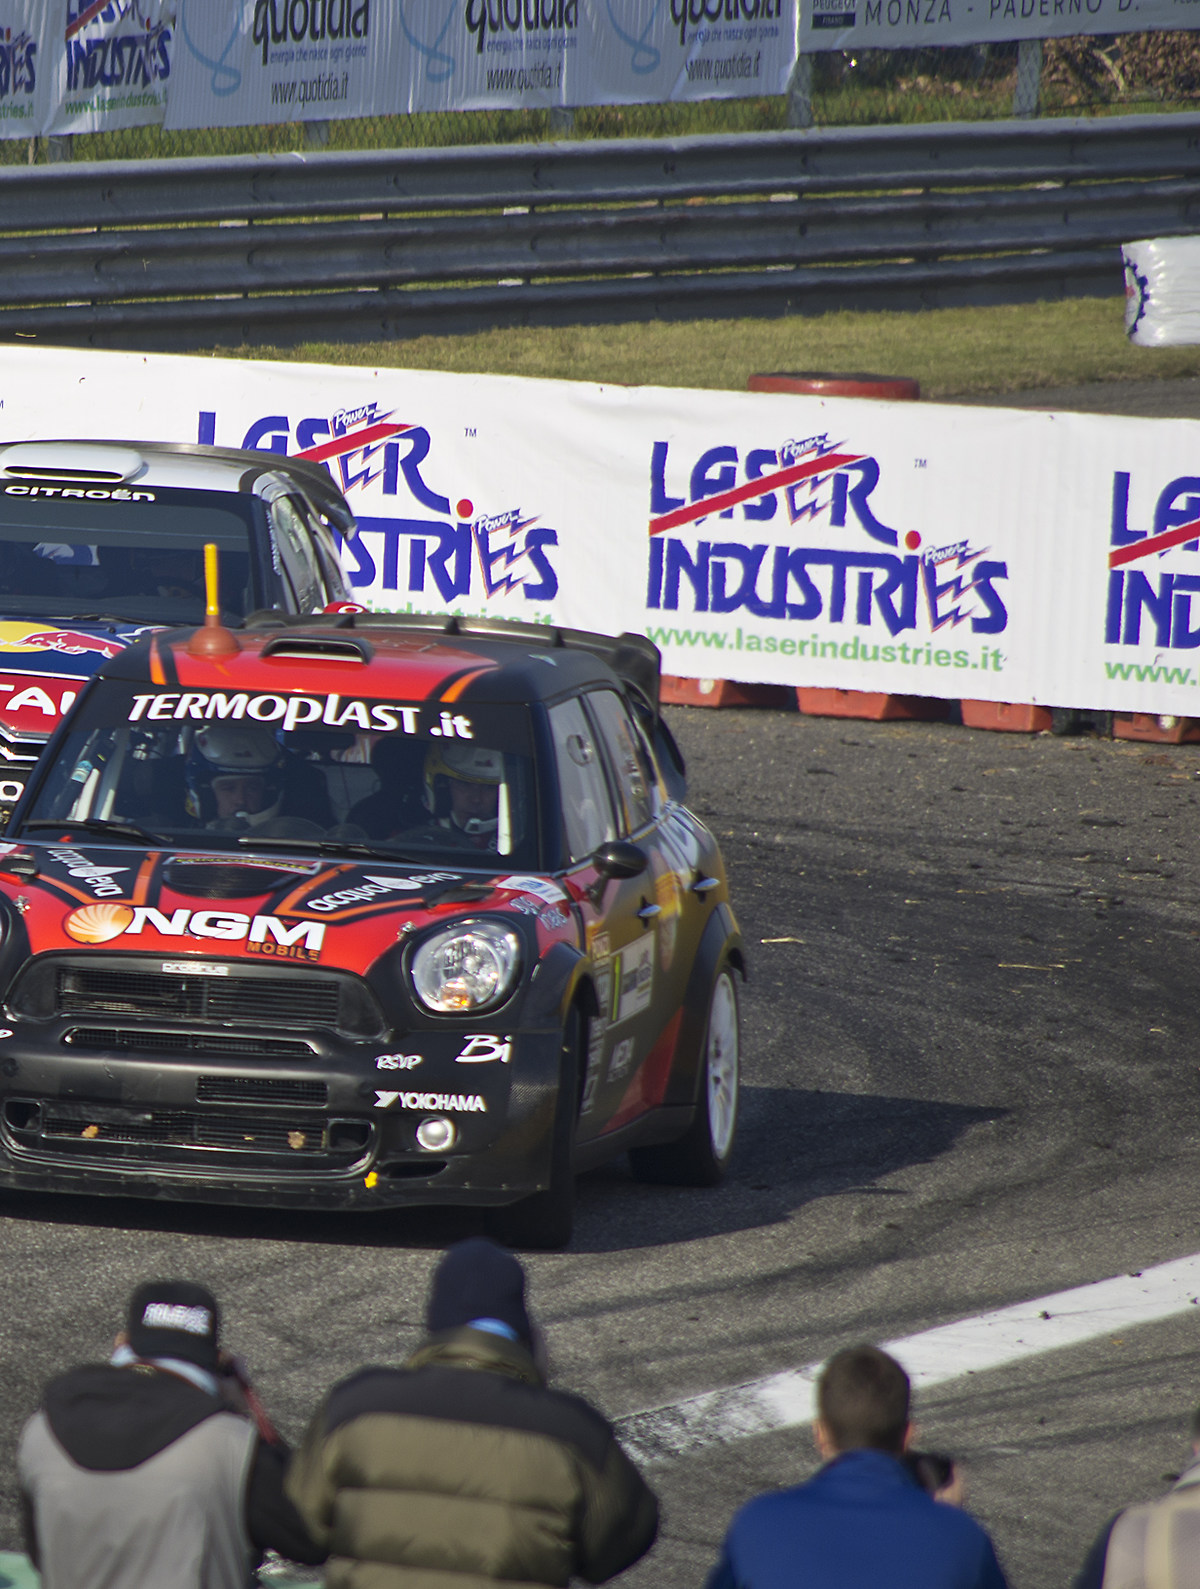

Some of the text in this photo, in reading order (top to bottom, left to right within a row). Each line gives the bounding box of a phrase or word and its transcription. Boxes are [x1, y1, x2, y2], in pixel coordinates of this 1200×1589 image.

[864, 0, 952, 26] MONZA
[271, 72, 349, 108] www.quotidia.it
[649, 436, 899, 546] LASER
[646, 537, 1009, 637] INDUSTRIES
[646, 625, 1004, 672] www.laserindustries.it
[429, 710, 473, 740] .it
[306, 884, 393, 912] acqua
[124, 906, 328, 951] NGM
[246, 941, 321, 961] MOBILE
[398, 1091, 487, 1112] YOKOHAMA
